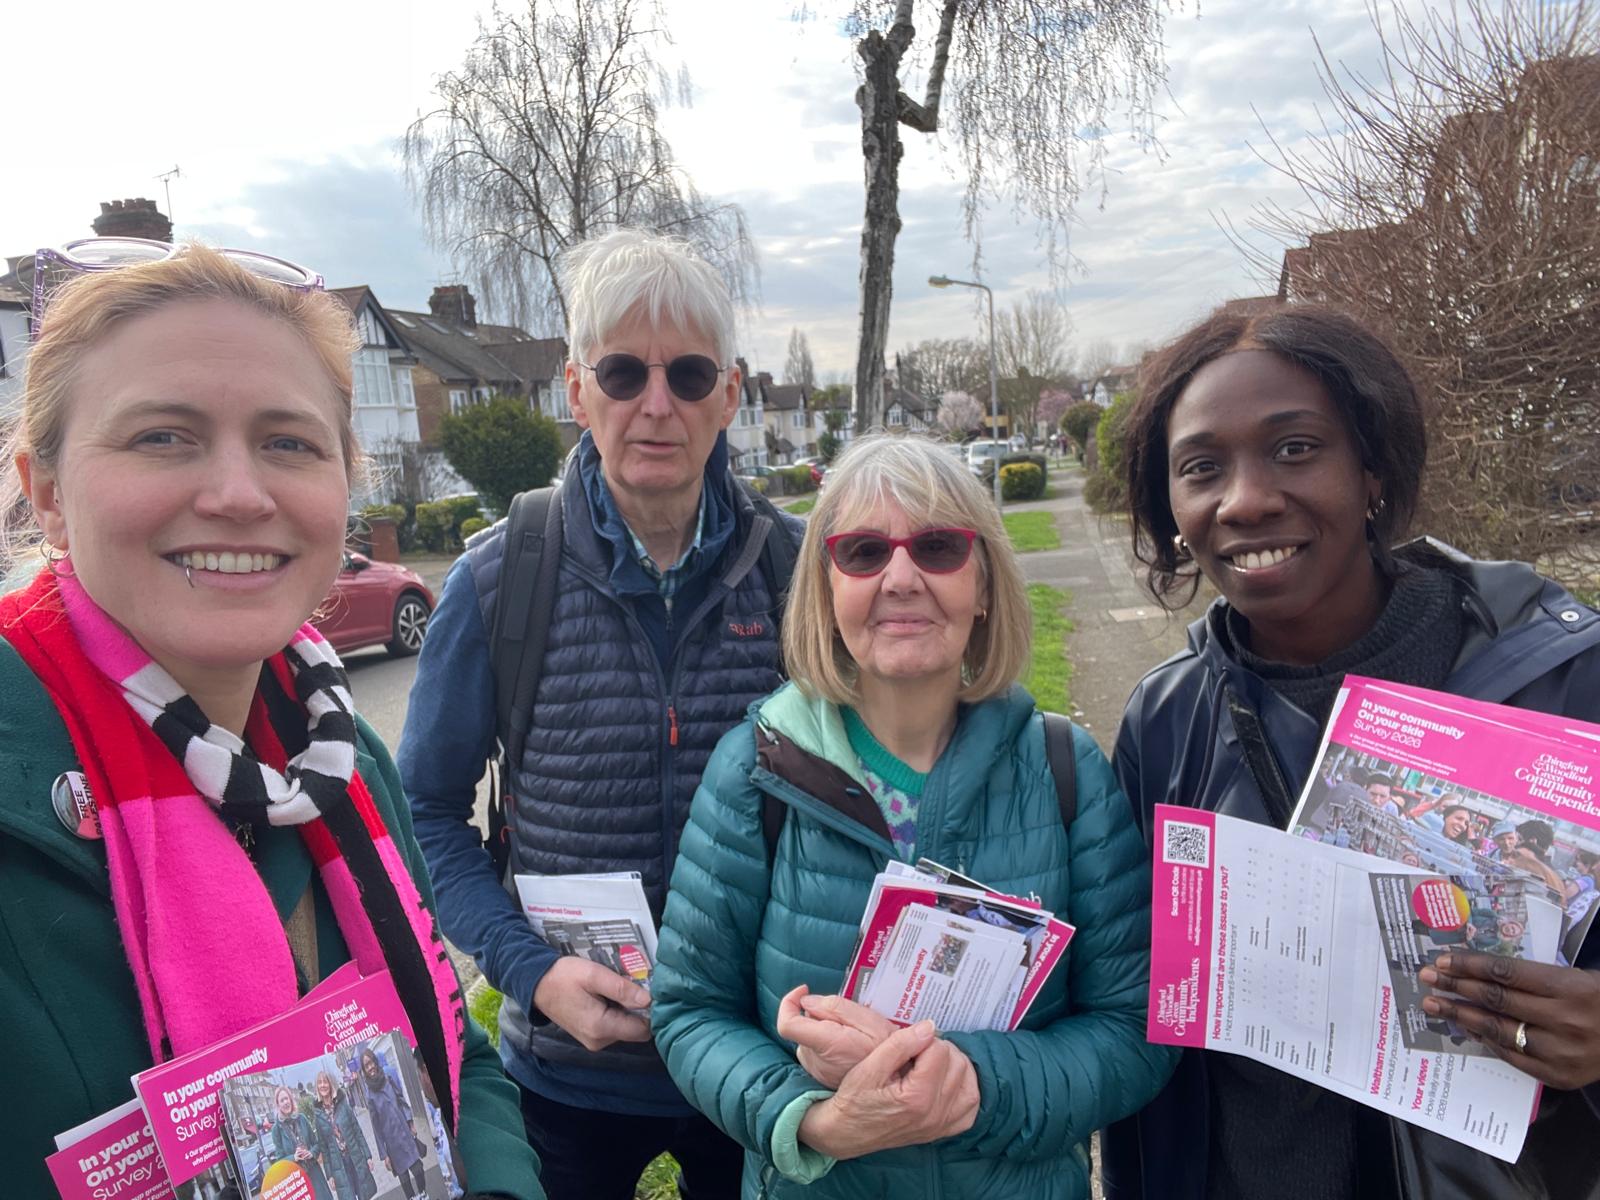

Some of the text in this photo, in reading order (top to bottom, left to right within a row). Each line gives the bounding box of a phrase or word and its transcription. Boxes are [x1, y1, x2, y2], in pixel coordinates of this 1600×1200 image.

[1354, 719, 1422, 748] Survey 2026
[1358, 710, 1424, 738] On your side
[1362, 698, 1464, 740] In your community
[1540, 754, 1588, 774] Chingford
[1545, 763, 1592, 784] Woodford
[1515, 768, 1596, 803] Community
[74, 790, 89, 819] FREE
[1528, 784, 1600, 817] Independe
[1220, 866, 1229, 889] you?
[1219, 890, 1228, 900] to
[1218, 902, 1228, 931] issues
[1040, 942, 1054, 962] your
[1050, 934, 1060, 943] In
[1218, 932, 1227, 956] these
[898, 992, 908, 1010] your
[906, 948, 928, 992] community
[1217, 957, 1226, 972] are
[903, 974, 926, 1020] On your side
[1186, 958, 1200, 1022] Independents
[324, 1000, 358, 1023] Chingford
[1157, 989, 1166, 1024] Chingford
[1174, 978, 1188, 1036] Community
[324, 1022, 379, 1054] Community
[1212, 1019, 1222, 1040] How
[1370, 986, 1391, 1095] Waltham Forest Council
[163, 1048, 268, 1106] In your community
[1416, 1058, 1430, 1087] views
[1384, 1081, 1392, 1100] How
[1411, 1087, 1424, 1111] Your
[170, 1108, 190, 1124] On
[189, 1092, 216, 1118] your
[1425, 1098, 1435, 1117] How
[176, 1111, 217, 1141] Survey
[78, 1156, 98, 1172] In
[99, 1130, 140, 1164] your
[199, 1140, 214, 1155] group
[86, 1166, 114, 1188] On
[114, 1142, 155, 1174] your
[192, 1157, 203, 1168] who
[93, 1162, 152, 1200] Survey
